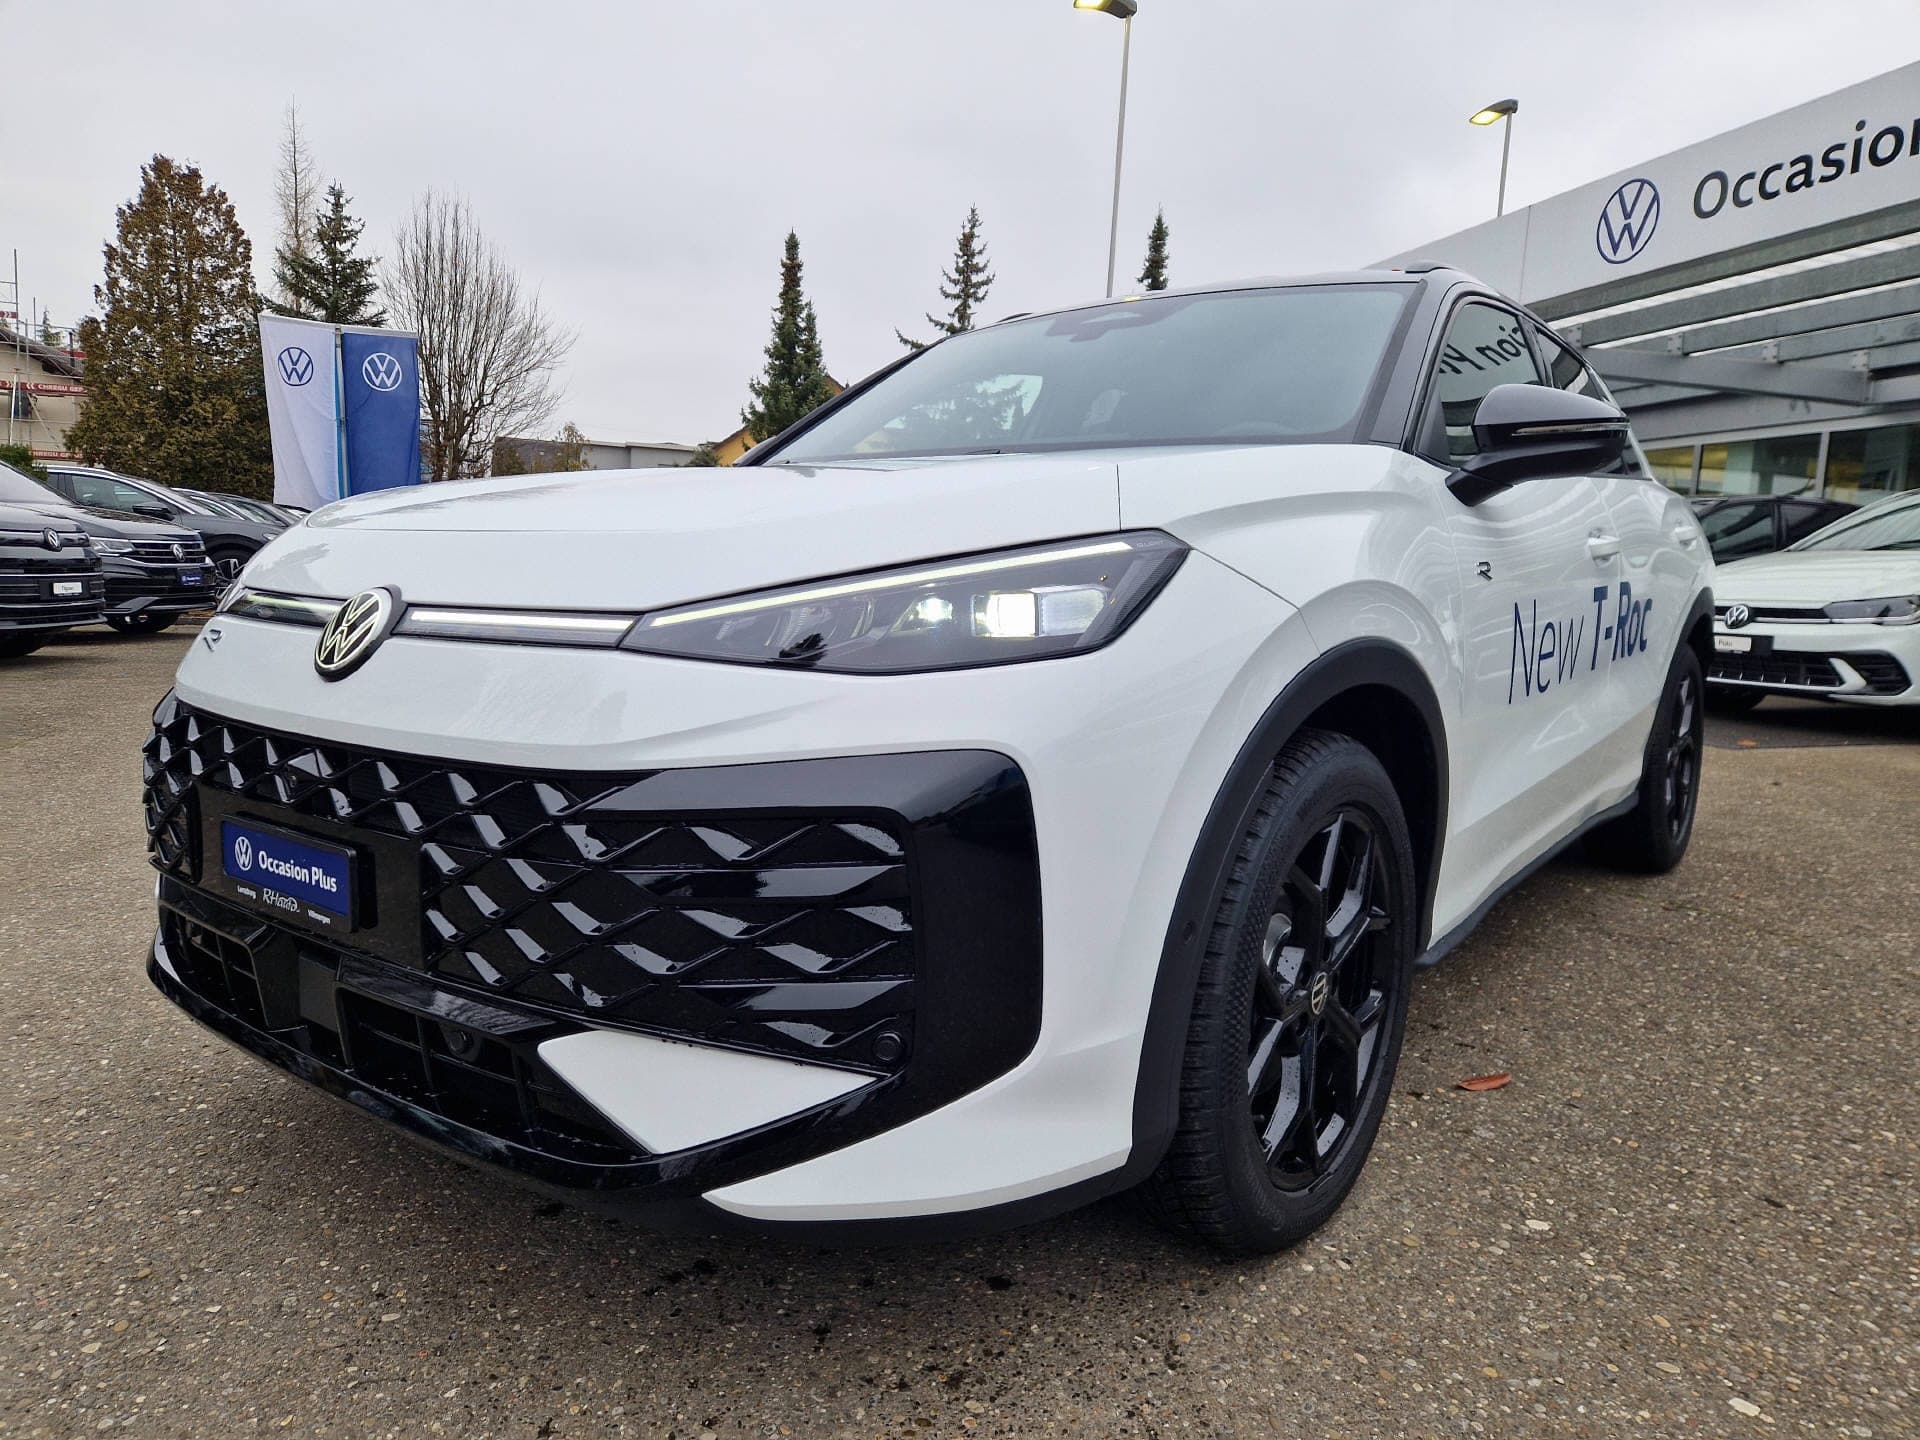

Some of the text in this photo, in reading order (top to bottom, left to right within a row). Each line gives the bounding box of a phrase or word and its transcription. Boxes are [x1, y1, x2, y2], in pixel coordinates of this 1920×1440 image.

[1508, 581, 1653, 705] New T-Roc
[258, 850, 309, 883] Occasion
[311, 866, 337, 893] Plus
